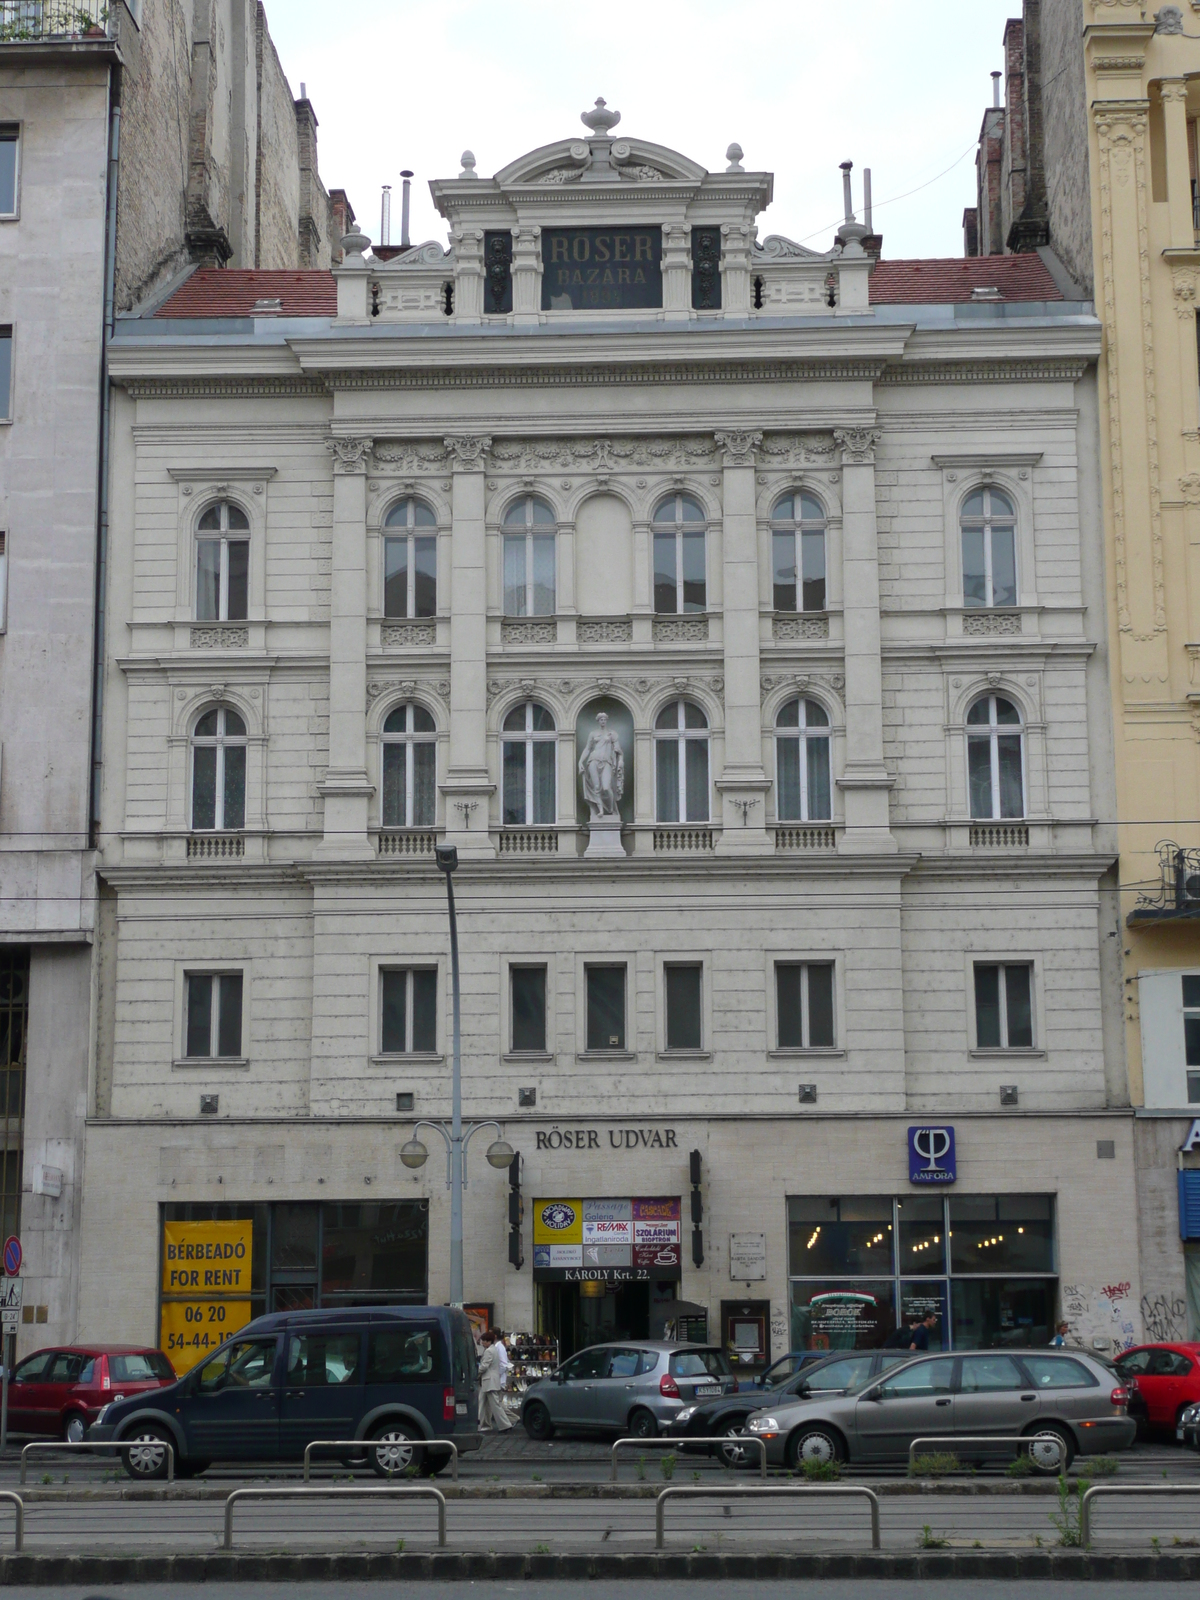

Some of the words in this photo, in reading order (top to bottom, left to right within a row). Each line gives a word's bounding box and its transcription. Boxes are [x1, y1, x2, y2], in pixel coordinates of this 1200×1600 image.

[558, 264, 647, 285] BAZÁRA
[535, 1125, 601, 1150] RÖSER
[608, 1128, 678, 1149] UDVAR
[912, 1172, 954, 1181] AMFORA
[542, 1204, 574, 1217] BROADWAY
[586, 1200, 629, 1213] Passage
[544, 1218, 571, 1229] HOLIDAY
[597, 1222, 629, 1232] RE/MAX
[635, 1227, 677, 1237] SZOLÁRIUM
[584, 1235, 629, 1245] Ingatlaniroda
[167, 1237, 246, 1261] BÉRBEADÓ
[170, 1270, 199, 1287] FOR
[204, 1269, 241, 1286] RENT
[565, 1269, 610, 1280] KÁROLY
[613, 1270, 633, 1280] Krt.
[637, 1270, 650, 1280] 22.
[185, 1306, 203, 1323] 06
[208, 1305, 226, 1322] 20
